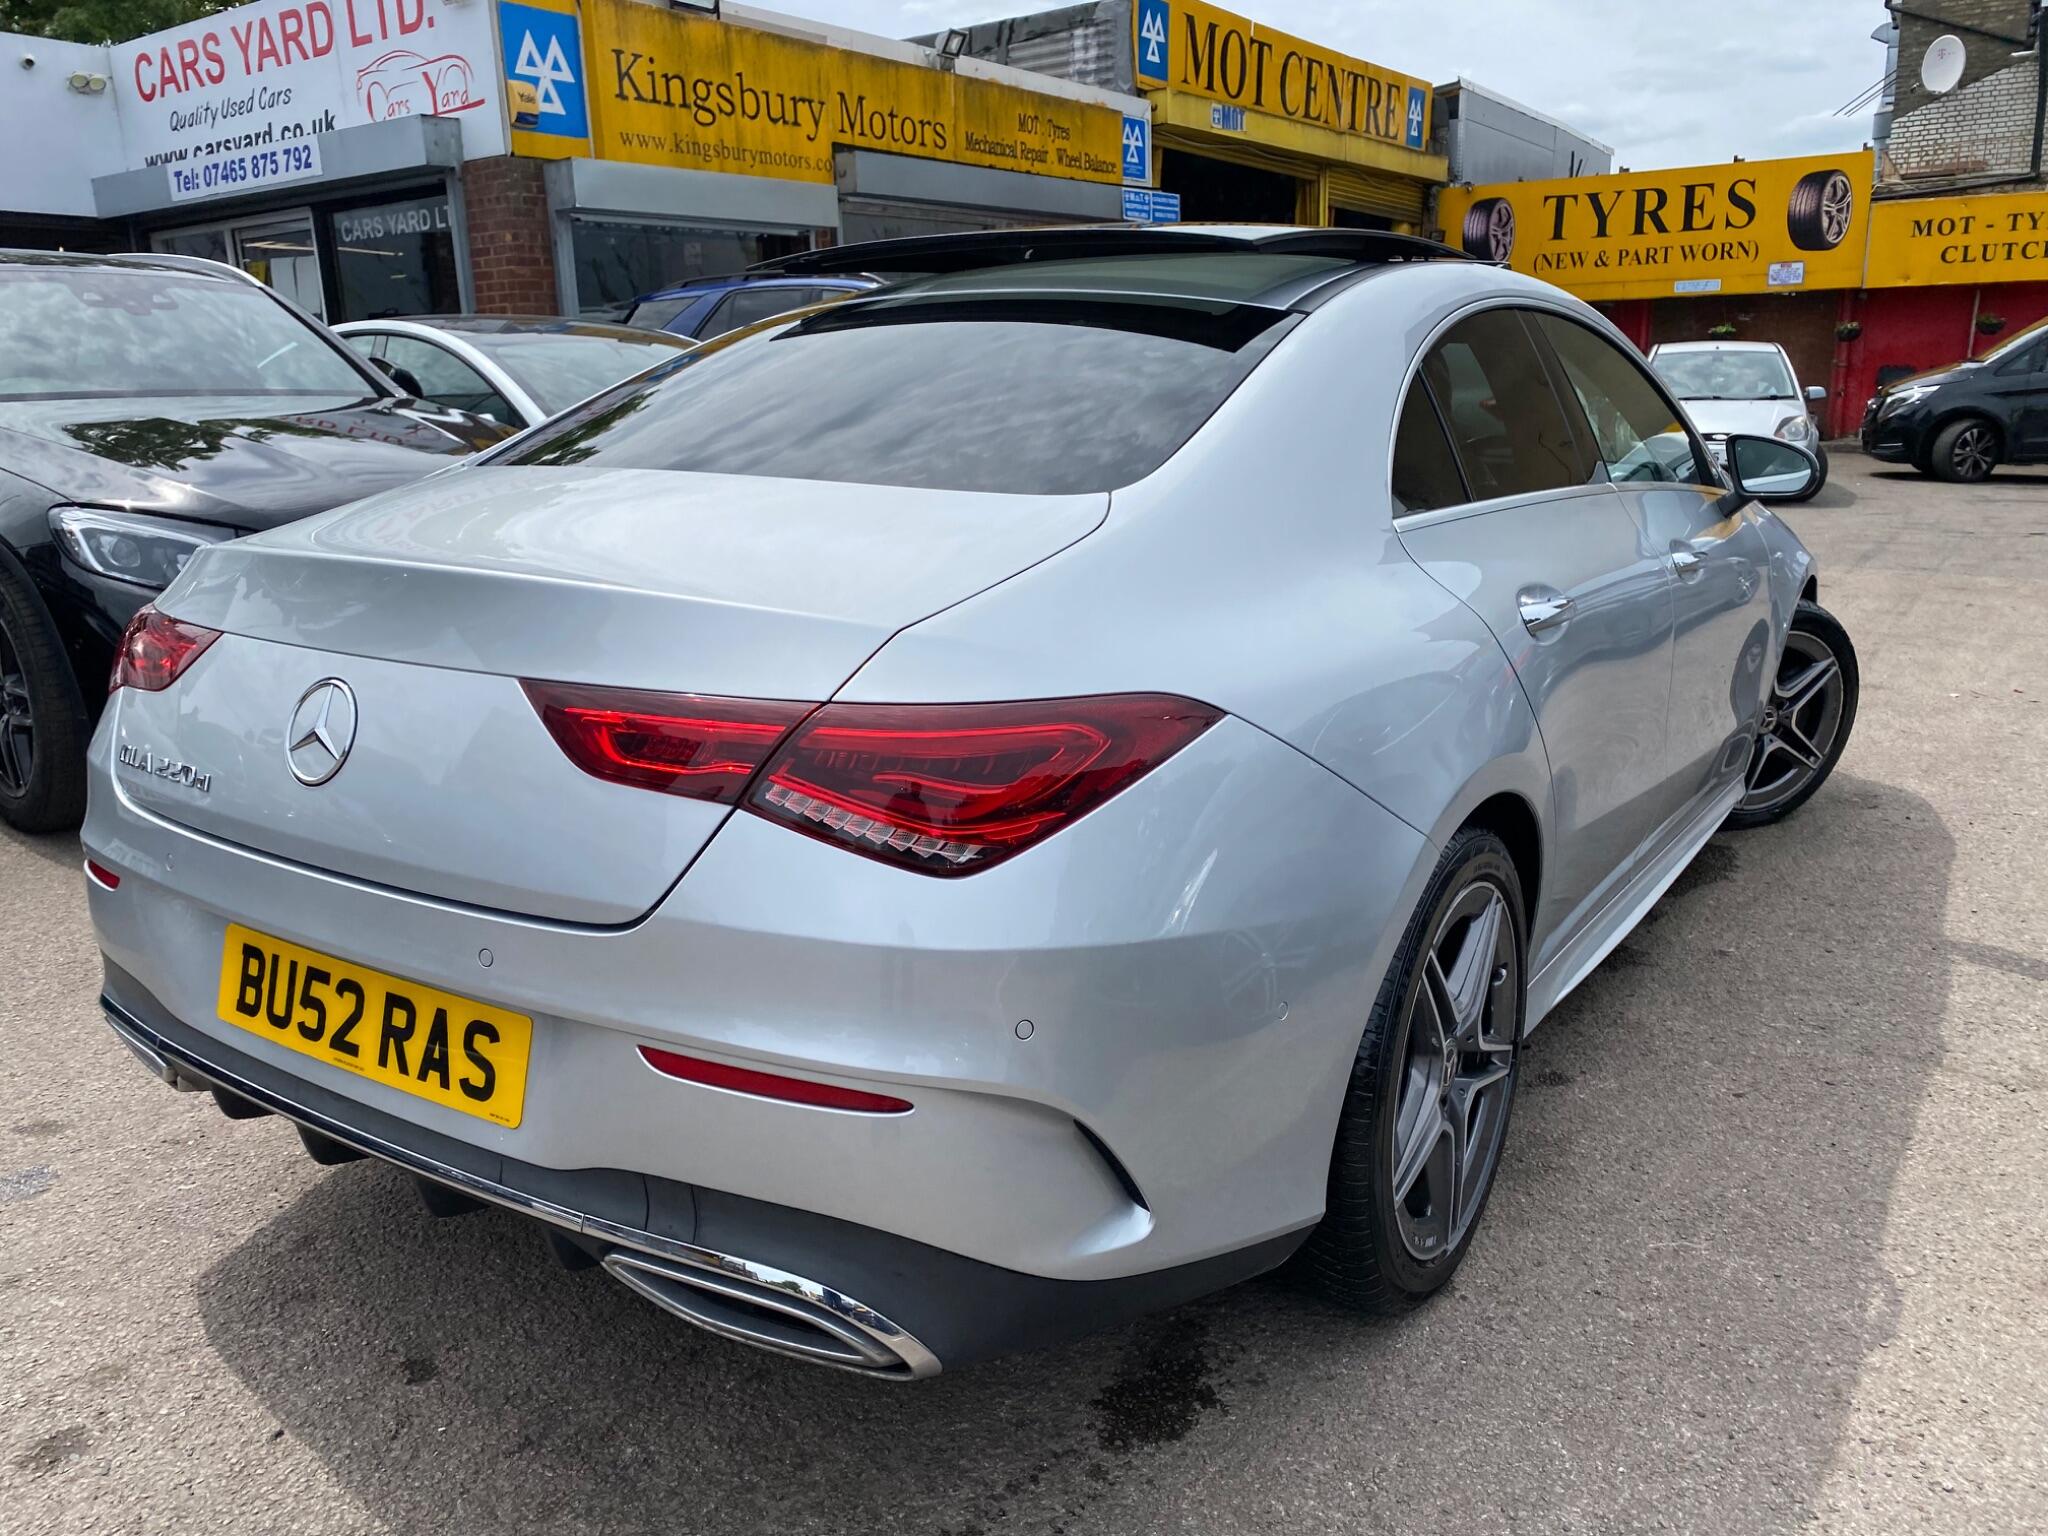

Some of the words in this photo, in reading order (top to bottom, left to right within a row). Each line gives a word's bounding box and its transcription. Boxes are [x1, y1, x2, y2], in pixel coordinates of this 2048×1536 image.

[134, 32, 225, 102] CARS
[231, 2, 334, 76] YARD
[1181, 12, 1273, 107] MOT
[1280, 50, 1400, 140] CENTRE
[170, 101, 219, 131] Quality
[221, 88, 255, 119] Used
[258, 86, 293, 111] Cars
[611, 48, 826, 142] Kingsbury
[837, 91, 948, 150] Motors
[1222, 104, 1246, 131] MOT
[144, 109, 336, 168] wwwcarsyard.co.uk
[1018, 113, 1039, 135] MOT
[1047, 119, 1071, 142] Tyres
[174, 168, 199, 193] Tel:
[203, 157, 247, 187] 07465
[251, 151, 279, 179] 875
[283, 144, 312, 173] 792
[965, 131, 1017, 159] Mechanical
[1020, 141, 1048, 167] Repair
[1056, 147, 1082, 170] Wheel
[1084, 152, 1117, 174] Balance
[341, 216, 384, 242] CARS
[386, 209, 431, 235] YARD
[1543, 178, 1756, 241] TYRES
[1911, 215, 1976, 238] MOT
[2007, 211, 2048, 232] TY
[1533, 251, 1589, 274] (NEW
[1594, 250, 1610, 268] &
[1617, 246, 1673, 266] PART
[1680, 240, 1759, 263] WORN)
[154, 758, 211, 792] 220d
[235, 943, 366, 1058] BU52
[377, 991, 501, 1102] RAS
